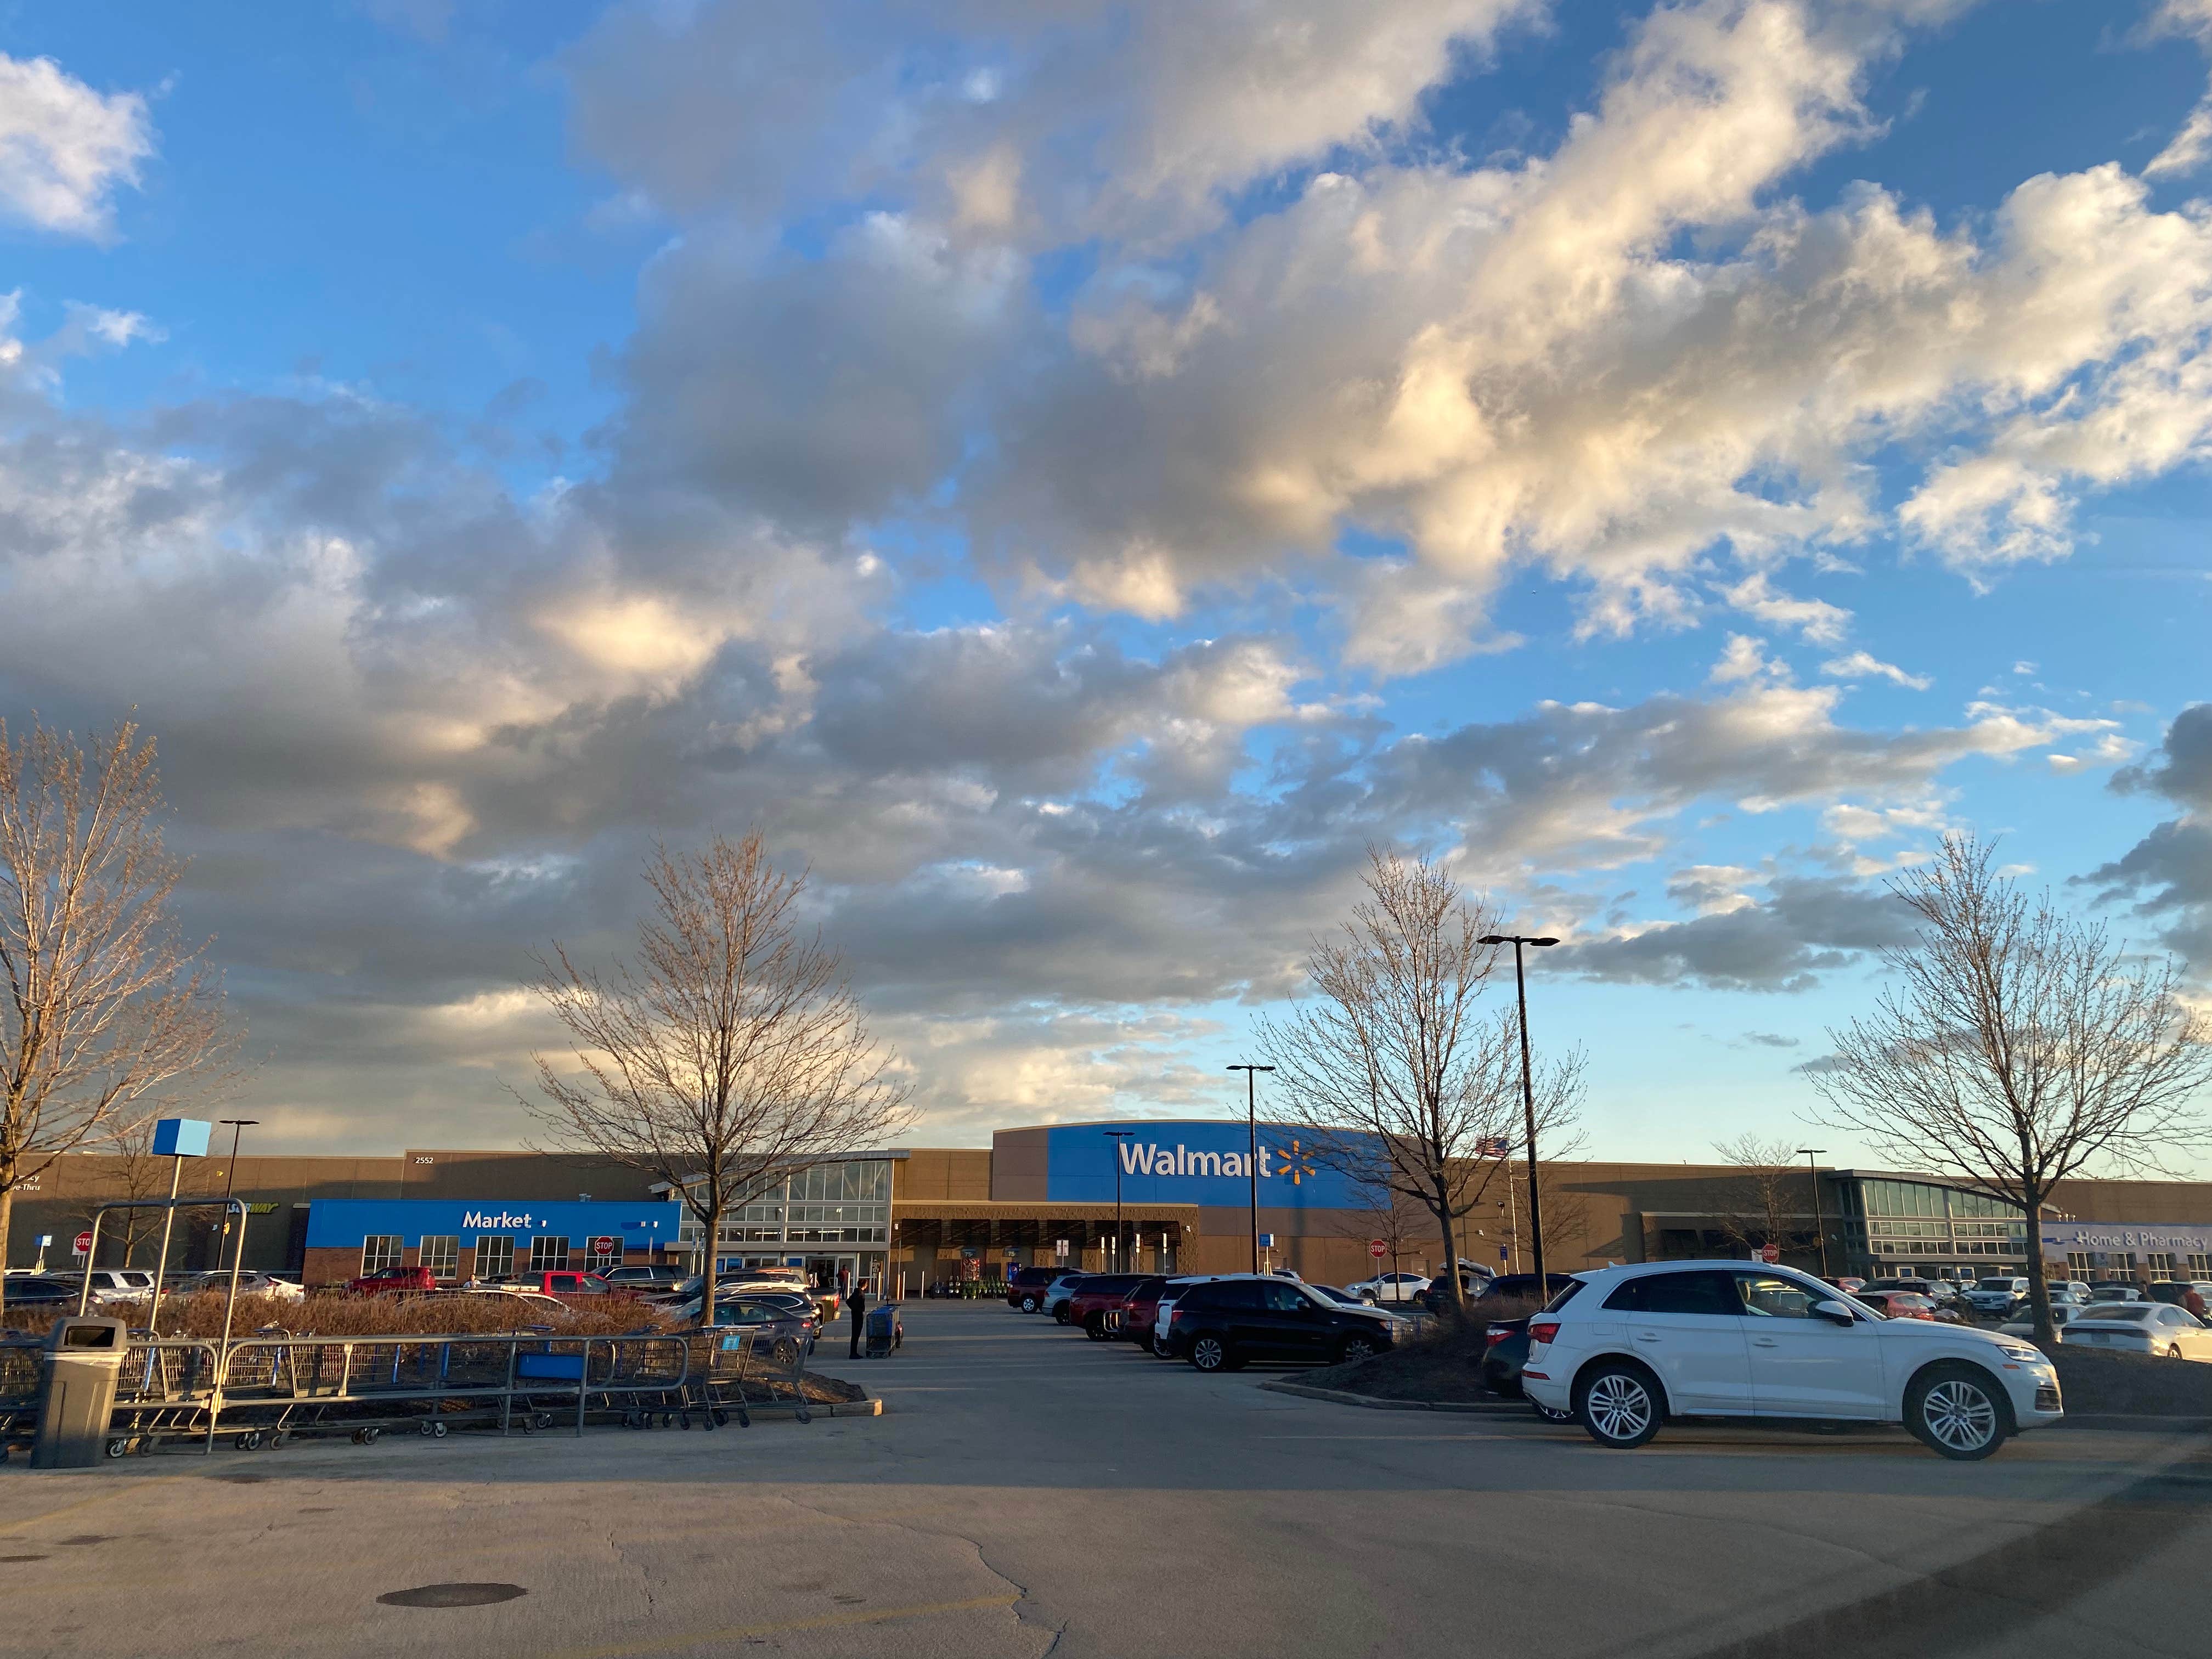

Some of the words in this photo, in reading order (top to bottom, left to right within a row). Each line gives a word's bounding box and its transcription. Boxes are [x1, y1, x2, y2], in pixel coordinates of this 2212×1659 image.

[1120, 1143, 1271, 1177] Walmart
[228, 1203, 279, 1213] SBWAY
[462, 1211, 532, 1228] Market
[77, 1238, 91, 1246] STO
[2076, 1231, 2121, 1246] Home
[2125, 1232, 2136, 1246] &
[2140, 1232, 2208, 1251] Pharmacy
